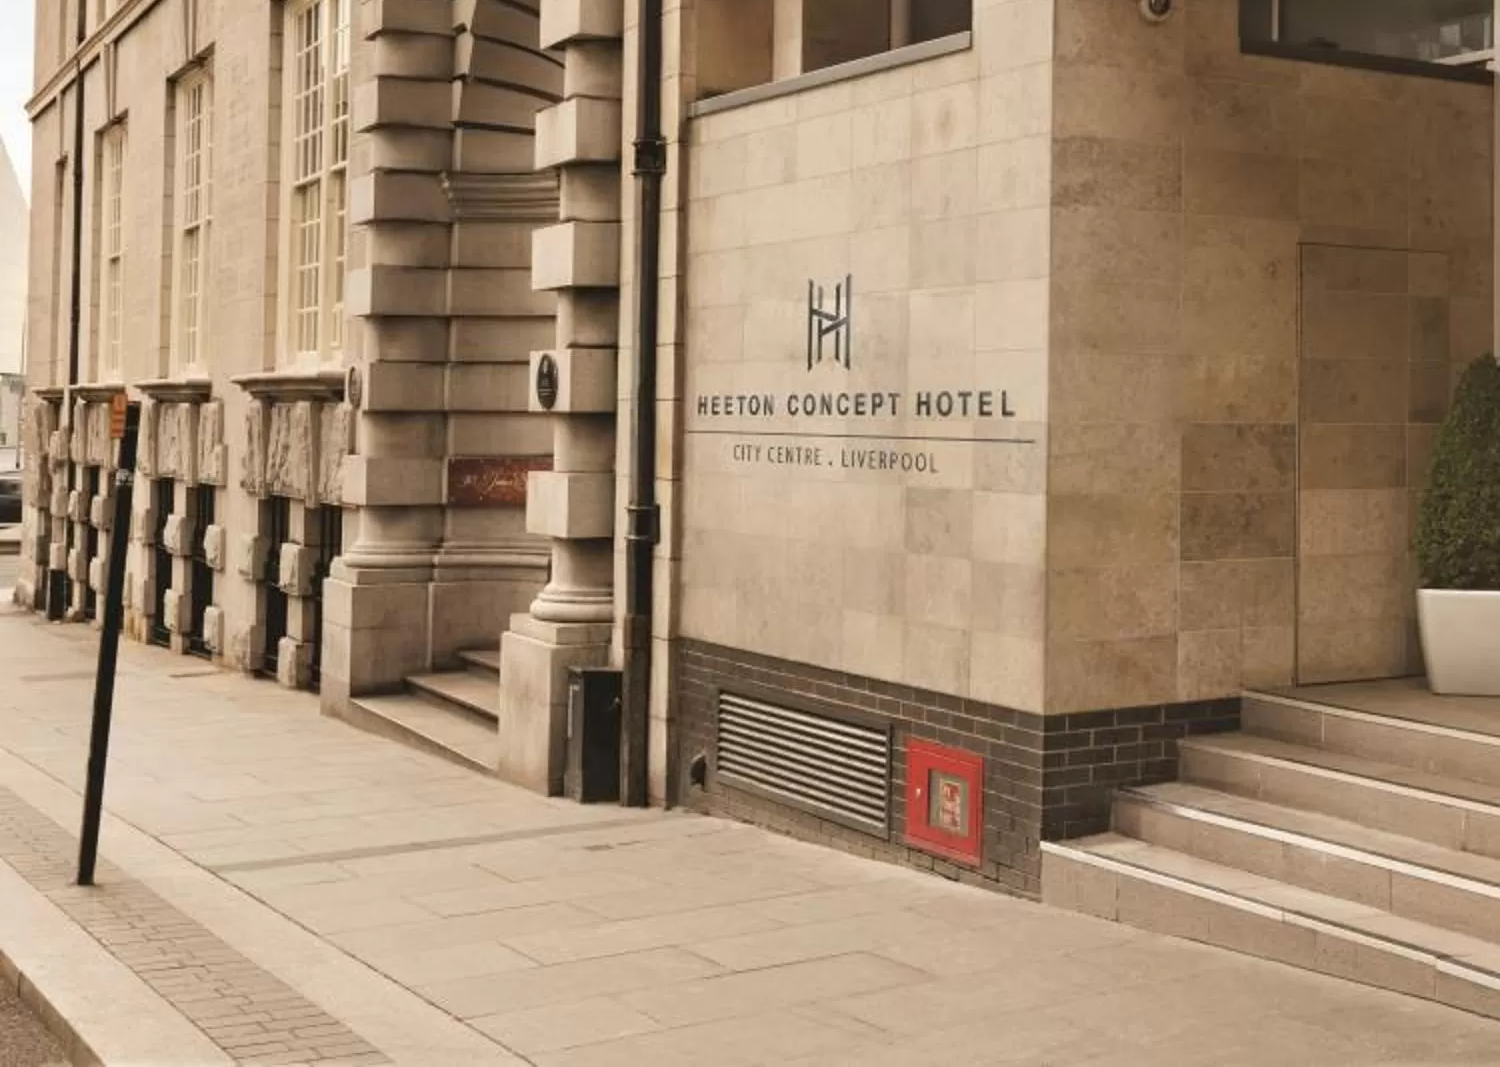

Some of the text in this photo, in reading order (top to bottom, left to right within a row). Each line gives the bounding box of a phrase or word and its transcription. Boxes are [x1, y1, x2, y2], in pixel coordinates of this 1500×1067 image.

[697, 389, 1016, 417] HEETON CONCEPT HOTEL
[732, 444, 761, 462] CITY
[841, 448, 939, 474] LIVERPOOL
